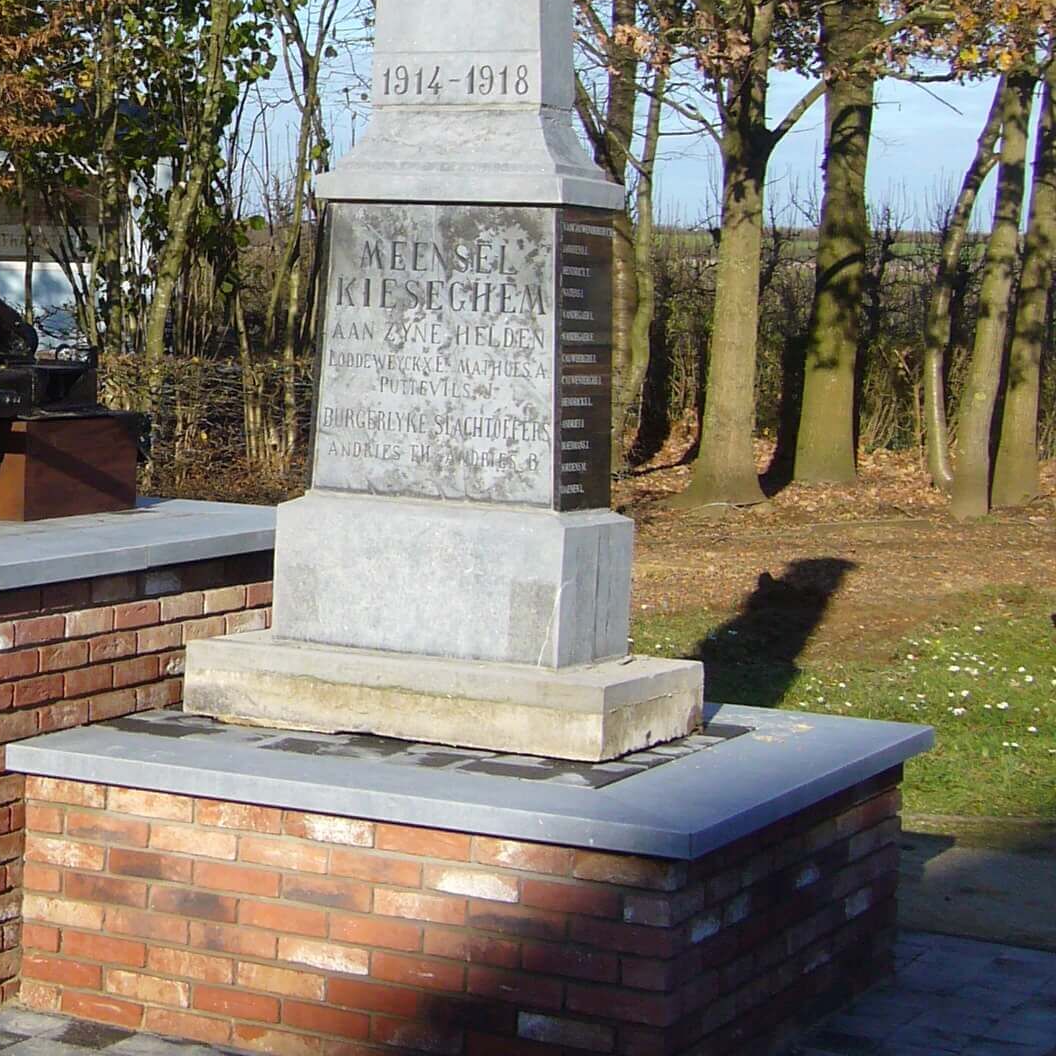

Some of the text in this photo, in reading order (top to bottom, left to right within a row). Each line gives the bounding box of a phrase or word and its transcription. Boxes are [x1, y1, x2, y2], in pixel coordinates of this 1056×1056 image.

[383, 64, 529, 95] 1914-1918
[360, 240, 518, 275] MEENSEL
[335, 277, 546, 315] KIESEGHEM
[332, 321, 375, 340] AAN
[384, 323, 442, 344] ZYNE
[456, 324, 545, 349] HELDEN
[323, 407, 551, 443] BURGERLYKE SLACHTOFFERS
